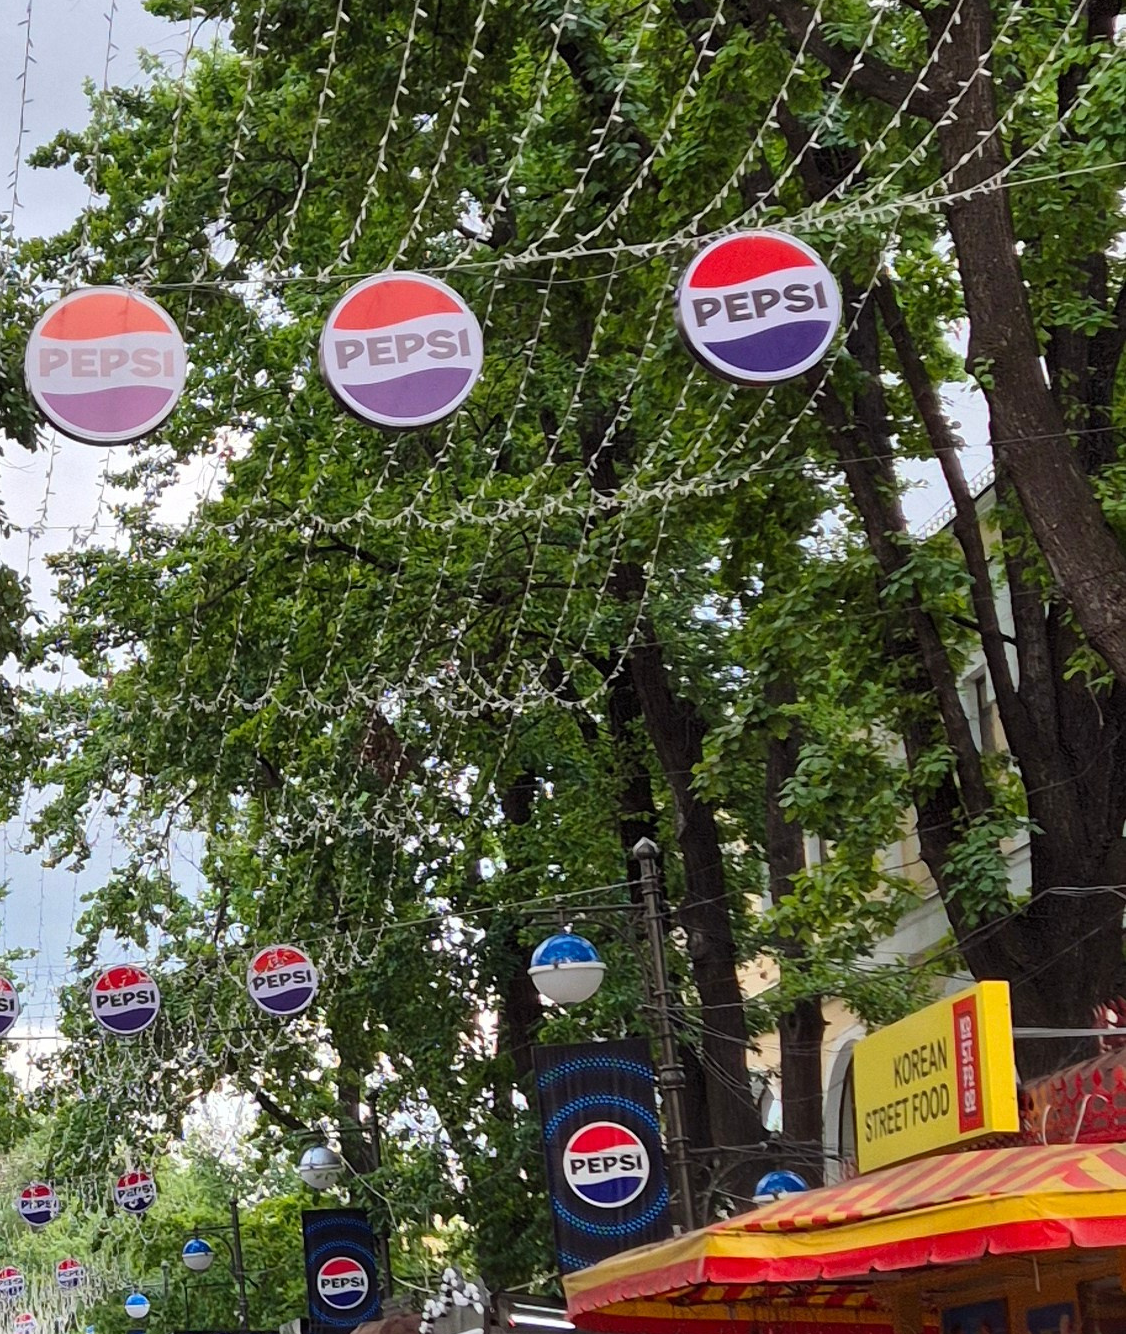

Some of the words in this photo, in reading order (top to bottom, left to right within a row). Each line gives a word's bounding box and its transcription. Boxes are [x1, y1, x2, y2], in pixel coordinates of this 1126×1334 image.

[692, 280, 829, 328] PEPSI
[39, 347, 174, 378] PEPSI
[335, 328, 471, 370] PEPSI
[252, 969, 312, 991] PEPSI
[96, 989, 156, 1008] PEPSI
[893, 1036, 948, 1088] KOREAN
[865, 1097, 909, 1143] STREET
[912, 1083, 950, 1126] FOOD
[570, 1154, 643, 1175] PEPSI
[321, 1277, 365, 1289] PEPSI
